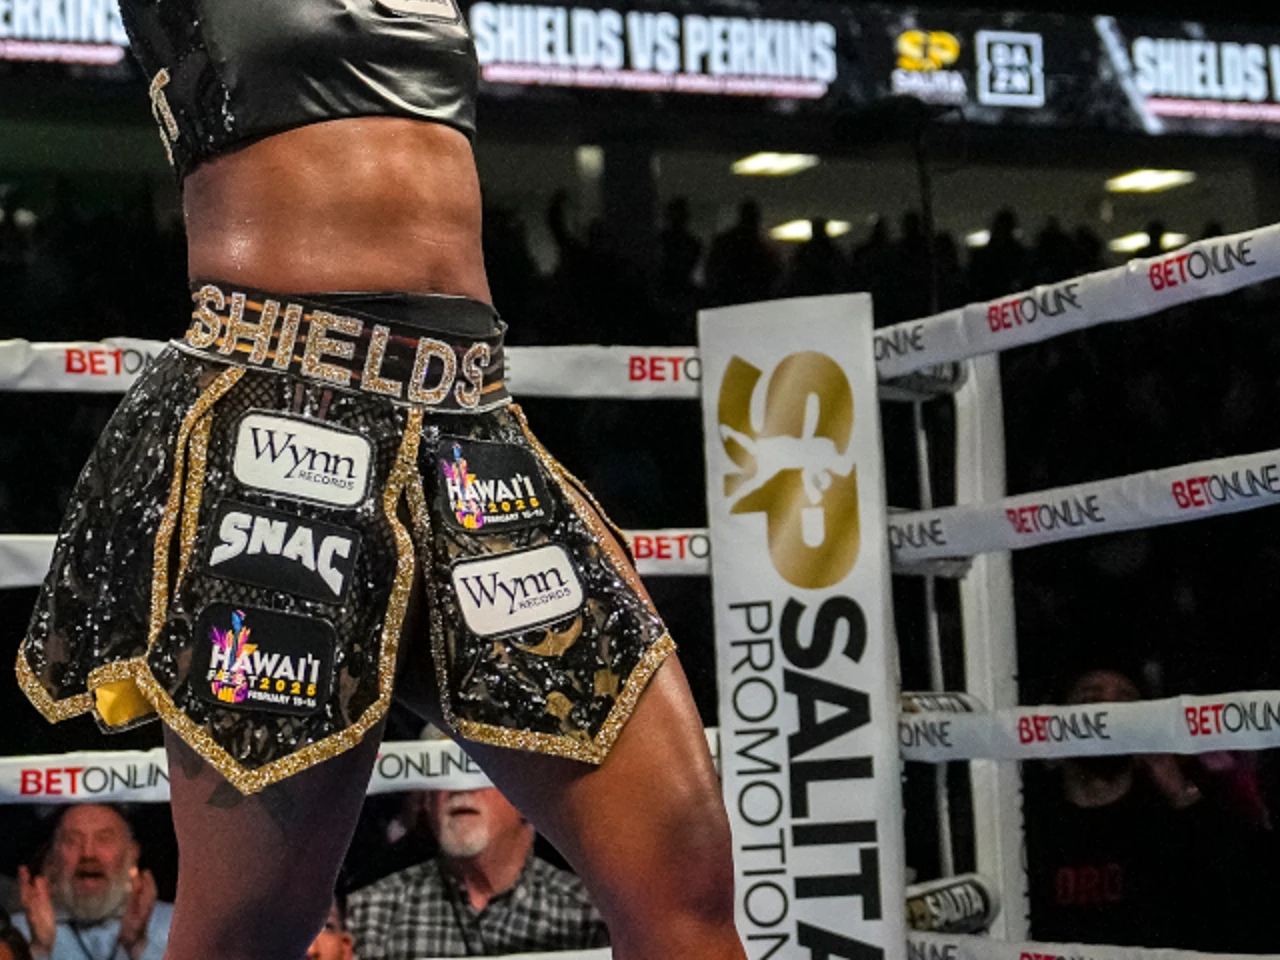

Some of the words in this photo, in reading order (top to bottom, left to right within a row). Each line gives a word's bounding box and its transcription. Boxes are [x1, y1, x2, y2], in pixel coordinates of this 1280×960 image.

[470, 1, 626, 69] SHIELDS
[628, 11, 679, 73] VS
[683, 15, 837, 84] PERKINS
[891, 68, 967, 96] SALITA
[1132, 36, 1267, 100] SHIELDS
[1149, 237, 1257, 291] BETONLINE
[187, 284, 491, 409] SHIELDS
[251, 426, 357, 479] Wynn
[297, 471, 355, 491] RECORDS
[487, 497, 540, 514] 2025
[209, 511, 351, 596] SNAC
[460, 567, 567, 615] Wynn
[518, 589, 572, 610] RECORDS
[206, 670, 259, 689] FEST
[259, 678, 317, 697] 2025
[247, 690, 291, 704] FEBRUARY
